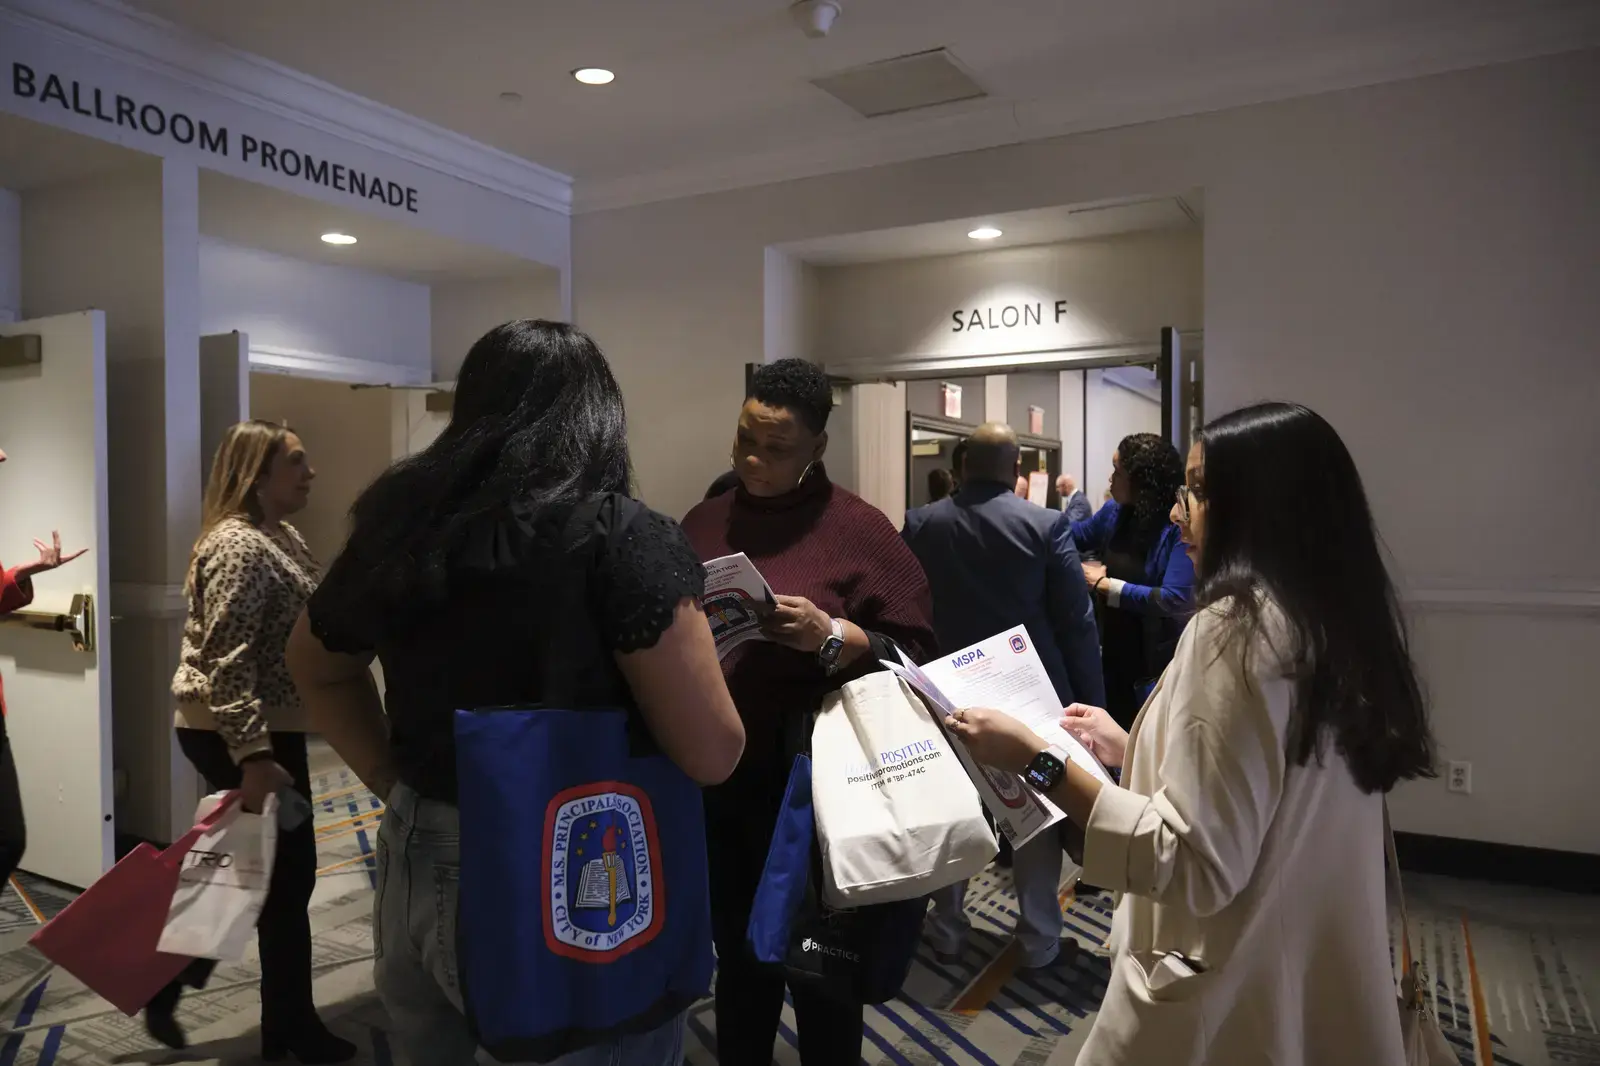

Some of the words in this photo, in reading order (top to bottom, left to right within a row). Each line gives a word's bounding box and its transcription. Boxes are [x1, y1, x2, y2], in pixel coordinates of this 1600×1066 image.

[12, 62, 228, 156] BALLROOM
[241, 134, 419, 213] PROMENADE
[952, 303, 1041, 332] SALON
[1055, 300, 1067, 324] F
[951, 648, 985, 669] MSPA
[880, 739, 936, 764] POSITIVE
[553, 857, 566, 888] M.S.
[554, 904, 582, 942] CITY
[585, 934, 600, 946] of
[606, 930, 625, 946] NEW
[627, 894, 650, 932] YORK
[811, 941, 860, 962] PRACTICE
